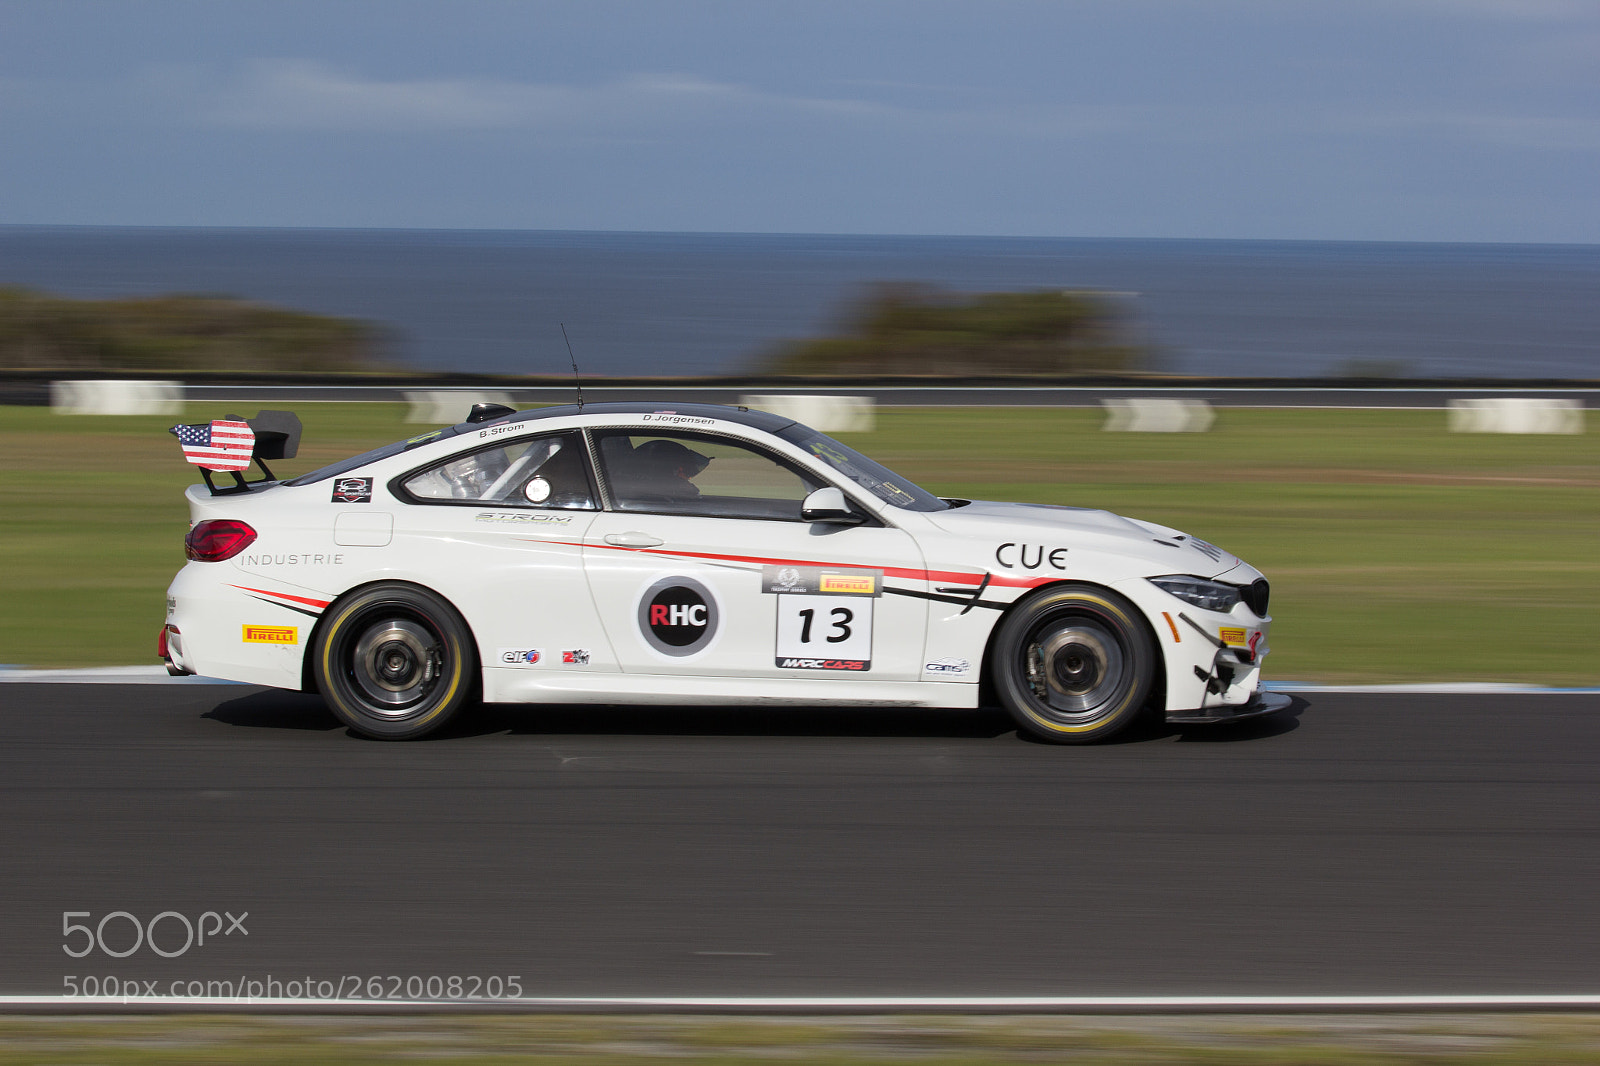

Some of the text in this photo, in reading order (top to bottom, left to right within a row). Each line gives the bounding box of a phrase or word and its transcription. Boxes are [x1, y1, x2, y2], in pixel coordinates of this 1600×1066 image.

[642, 414, 716, 426] D.Jorgensen
[479, 422, 525, 438] B.Strom
[241, 554, 345, 566] INDUSTRIE
[996, 541, 1069, 571] CUE
[825, 578, 870, 590] PIRELLI
[651, 604, 707, 626] RHC
[799, 607, 853, 644] 13
[246, 628, 294, 642] PIRELLI
